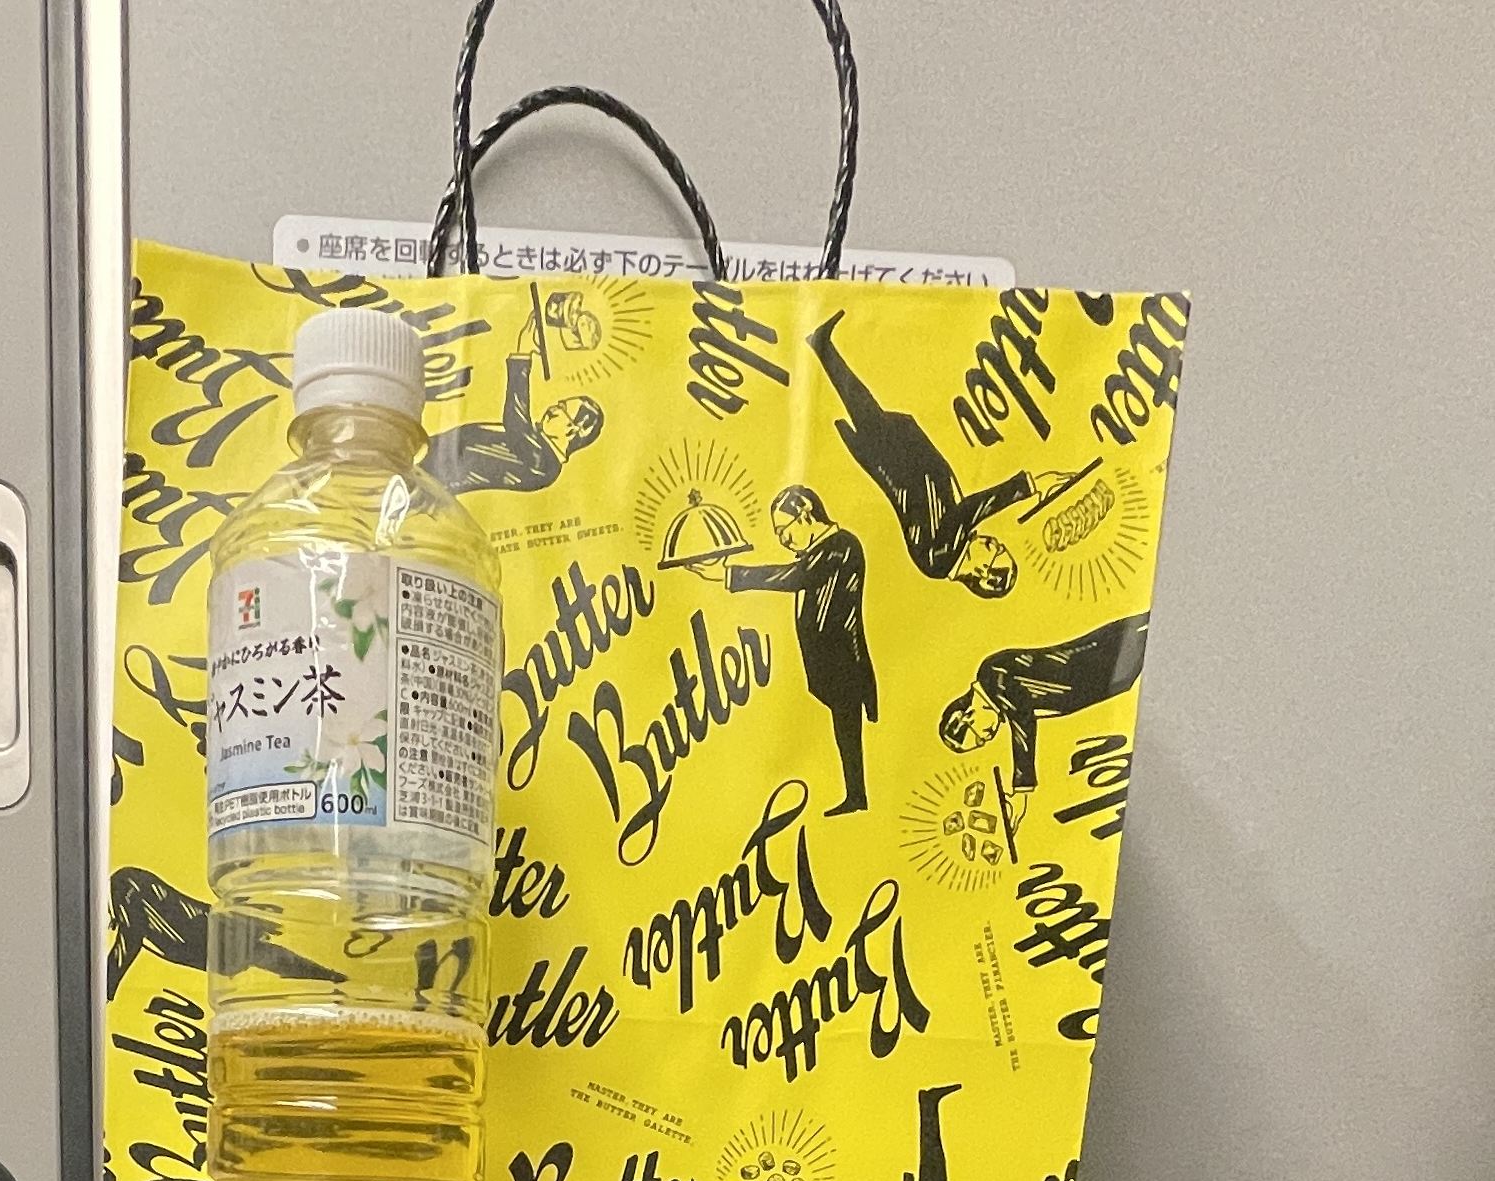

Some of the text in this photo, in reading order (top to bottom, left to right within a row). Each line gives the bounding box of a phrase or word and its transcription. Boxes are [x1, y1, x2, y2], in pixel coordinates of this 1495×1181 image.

[1091, 292, 1191, 445] utter
[527, 534, 571, 549] BUTTER
[211, 664, 346, 733] ャスミン茶
[220, 734, 291, 762] Jasmine Tea
[568, 609, 770, 866] Butler
[274, 803, 305, 815] bottle
[623, 779, 833, 1015] Butler
[721, 879, 932, 1084] Butter
[570, 1088, 591, 1103] THE
[596, 1099, 637, 1122] BUTTER
[631, 1099, 658, 1116] THEY
[662, 1113, 683, 1127] ARE
